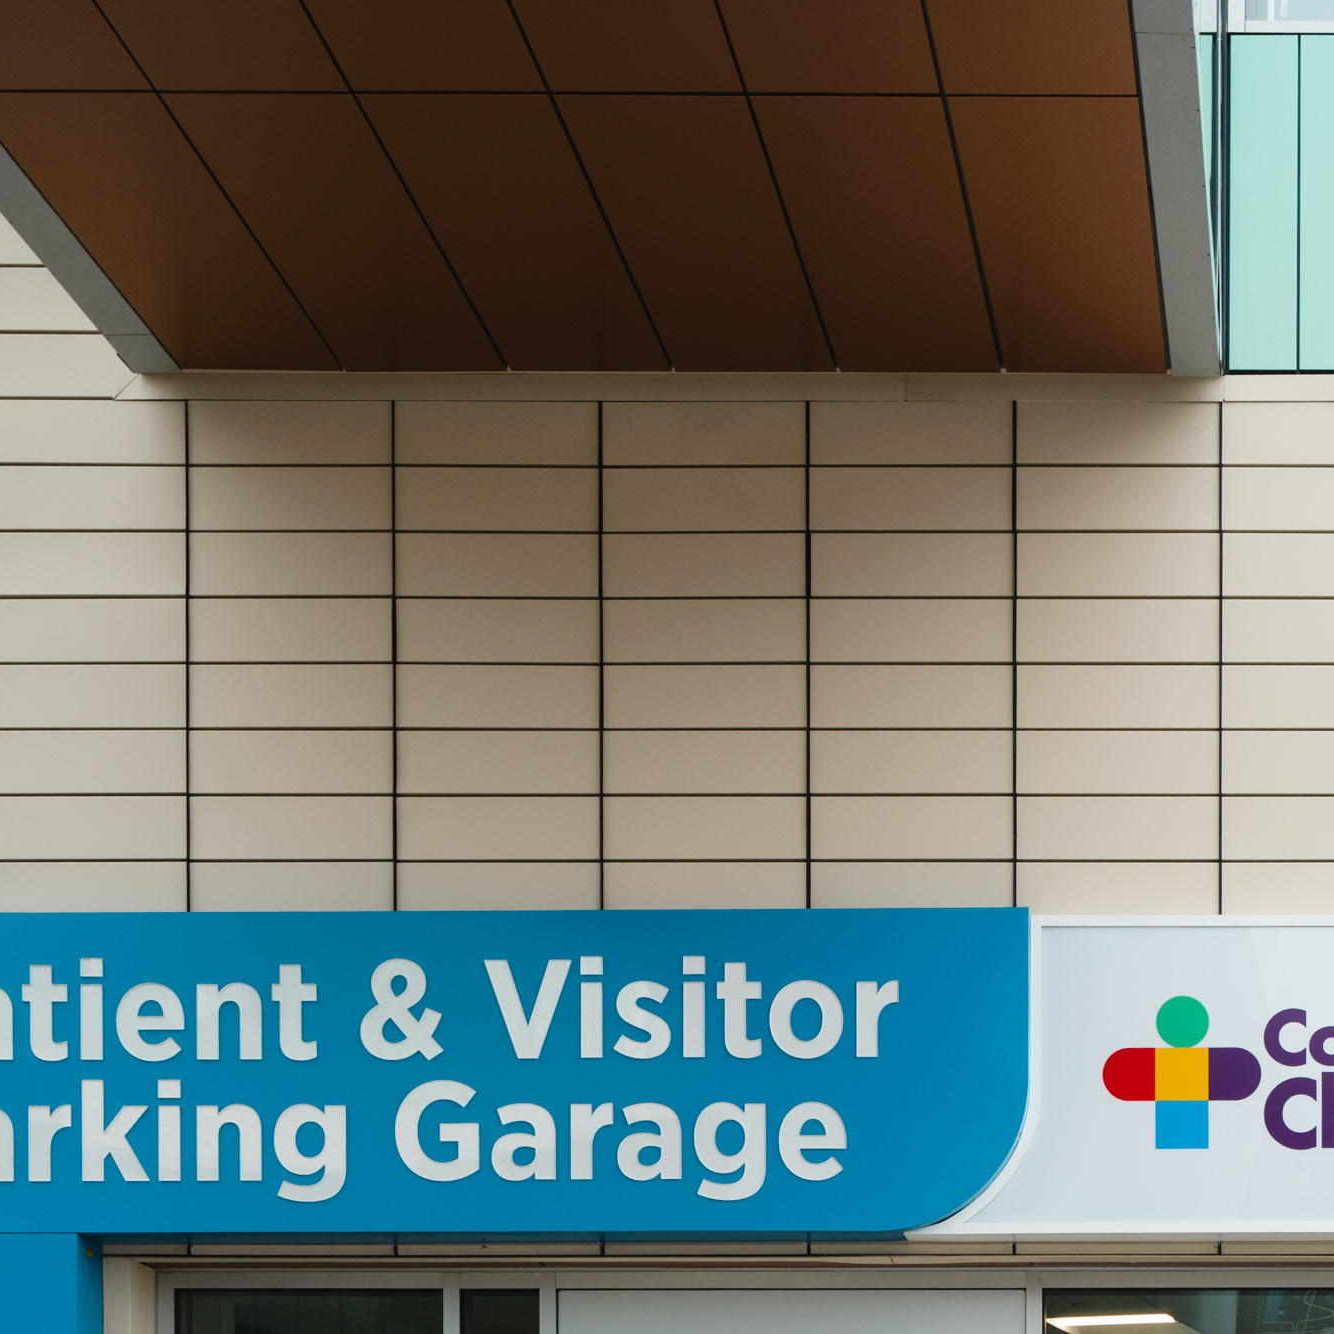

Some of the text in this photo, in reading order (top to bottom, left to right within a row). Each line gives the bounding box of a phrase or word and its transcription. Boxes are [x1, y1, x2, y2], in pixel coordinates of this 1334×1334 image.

[361, 959, 443, 1061] &
[485, 957, 898, 1060] Visitor
[395, 1081, 846, 1201] Garage
